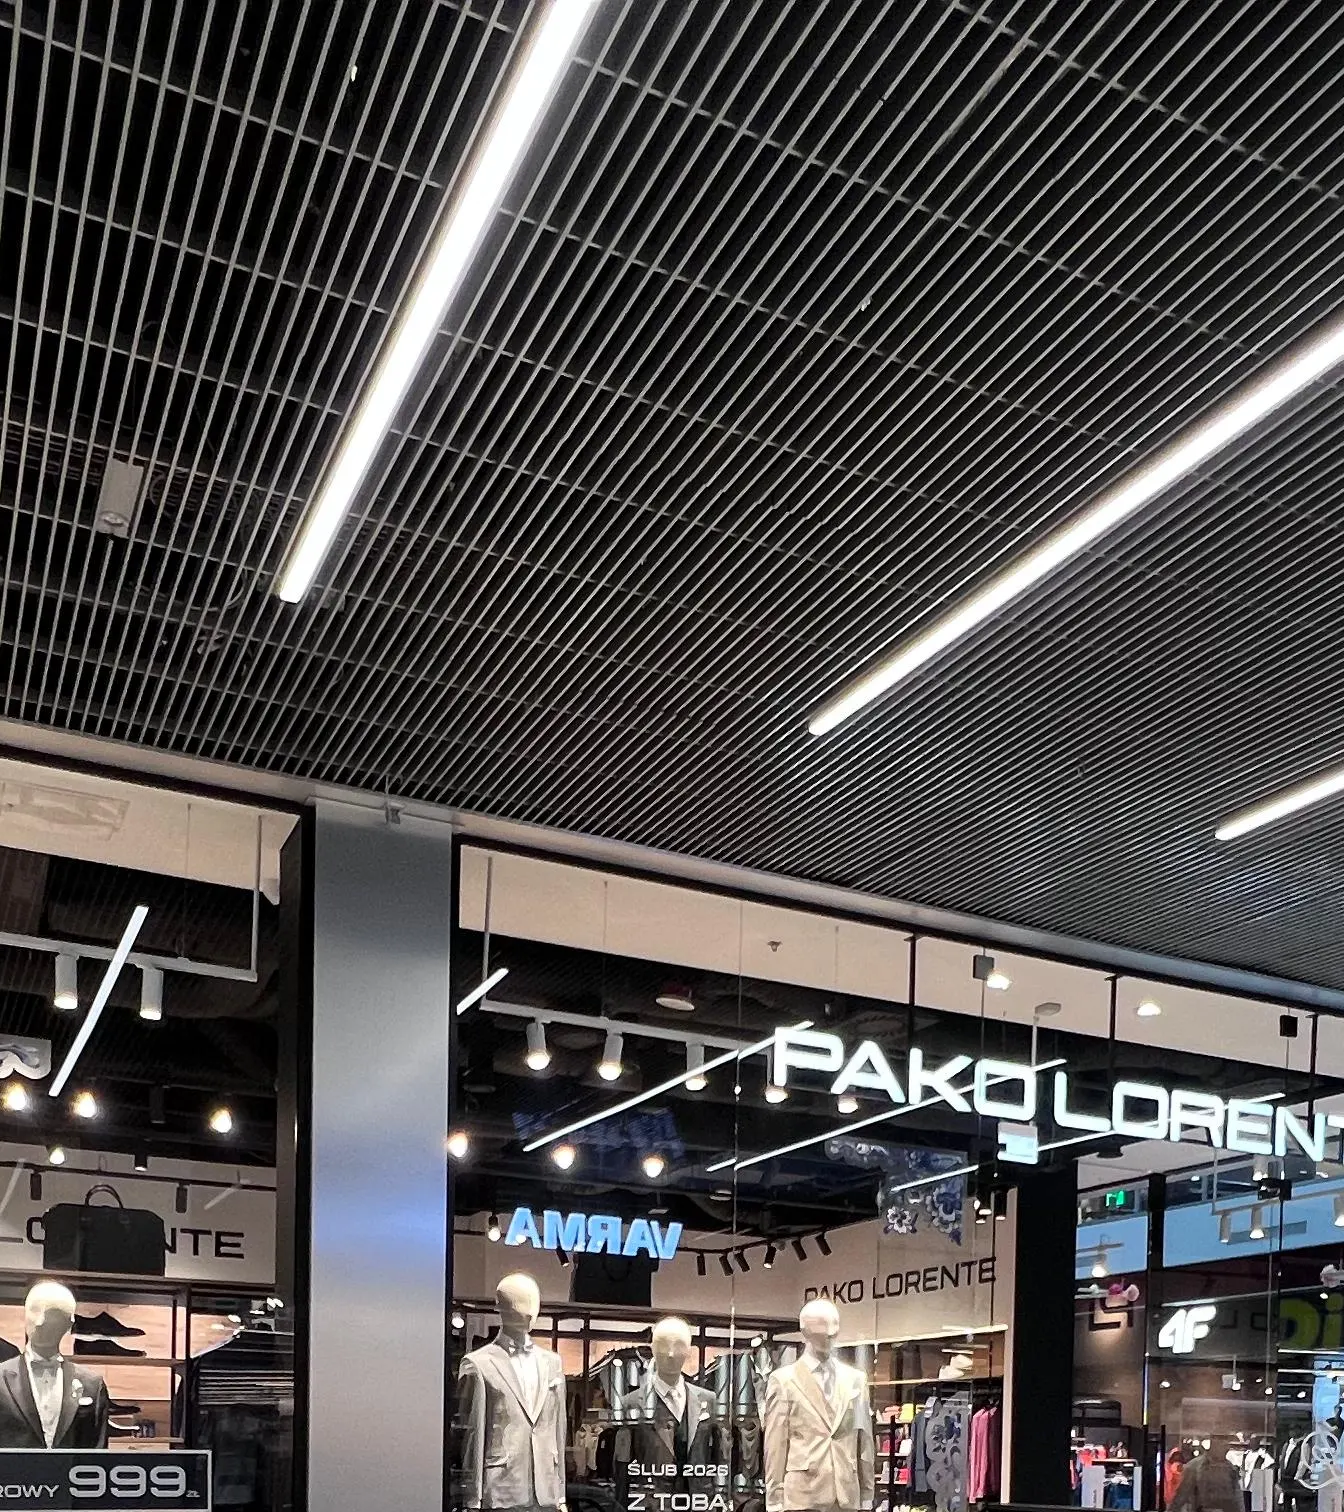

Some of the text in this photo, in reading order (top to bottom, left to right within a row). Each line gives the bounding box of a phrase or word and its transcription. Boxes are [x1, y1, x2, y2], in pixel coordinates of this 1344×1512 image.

[771, 1027, 1037, 1122] PAKO
[872, 1256, 997, 1300] LORENTE
[1158, 1304, 1217, 1354] 4F
[68, 1465, 187, 1498] 999
[627, 1459, 729, 1477] ŚLUB 2026
[627, 1493, 646, 1512] Z
